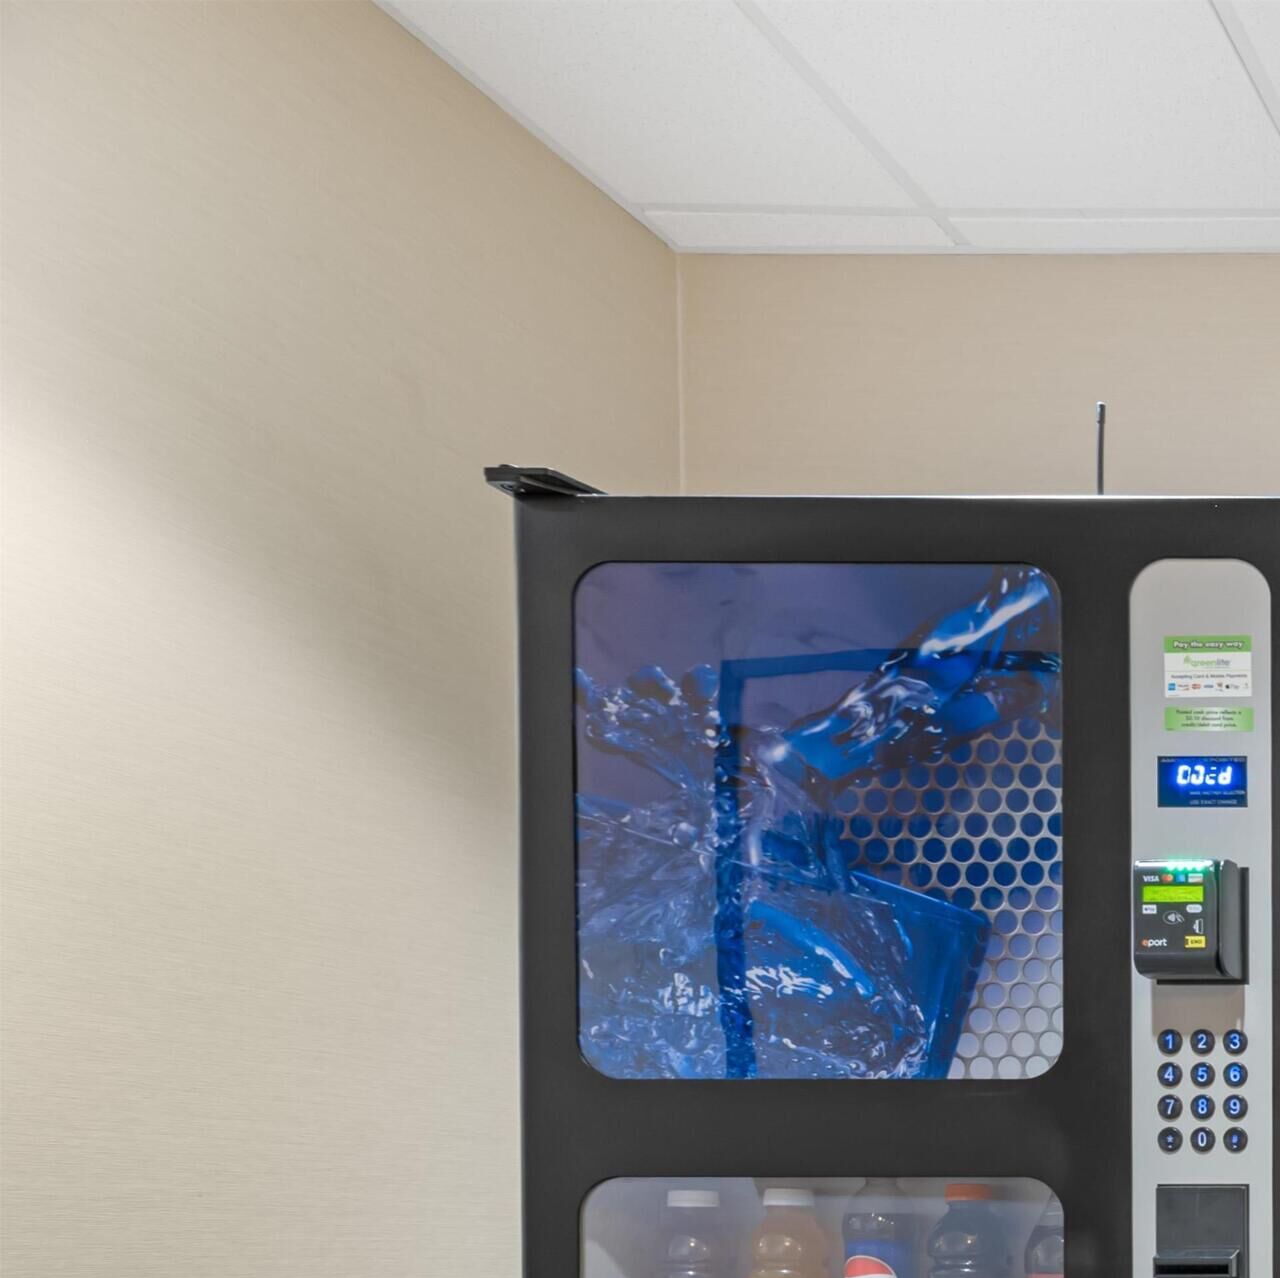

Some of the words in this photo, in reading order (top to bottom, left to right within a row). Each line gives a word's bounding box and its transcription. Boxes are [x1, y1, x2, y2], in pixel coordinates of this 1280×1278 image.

[1142, 938, 1168, 948] eport
[1165, 1034, 1173, 1049] 1
[1197, 1034, 1207, 1048] 2
[1229, 1033, 1240, 1049] 3
[1164, 1066, 1174, 1082] 4
[1197, 1067, 1208, 1082] 5
[1229, 1066, 1240, 1082] 6
[1165, 1099, 1175, 1115] 7
[1198, 1098, 1207, 1114] 8
[1230, 1098, 1240, 1114] 9
[1198, 1131, 1207, 1147] 0
